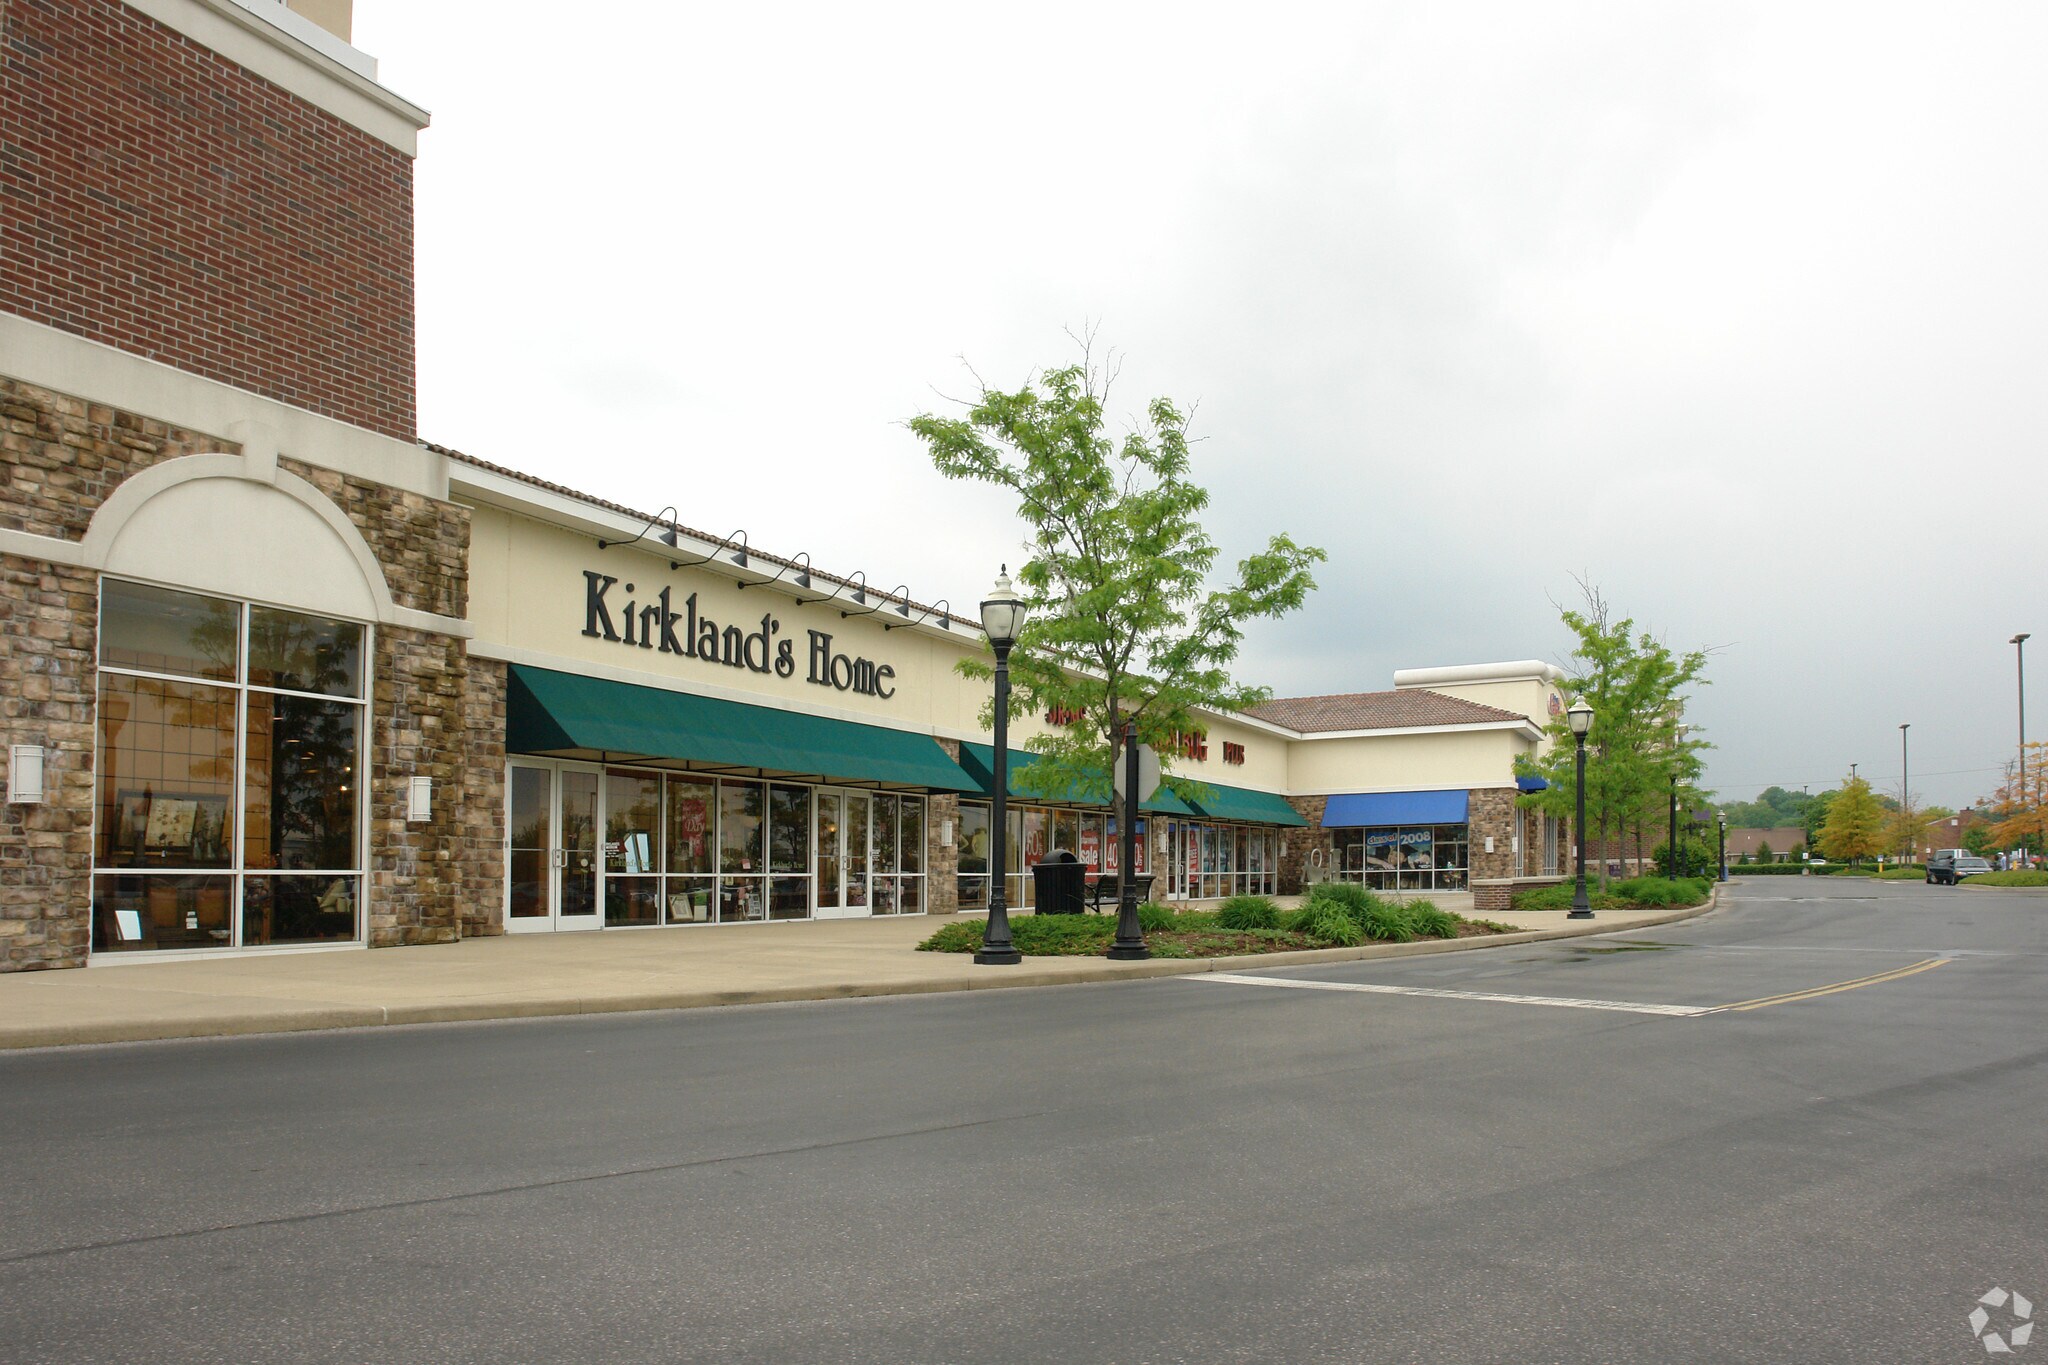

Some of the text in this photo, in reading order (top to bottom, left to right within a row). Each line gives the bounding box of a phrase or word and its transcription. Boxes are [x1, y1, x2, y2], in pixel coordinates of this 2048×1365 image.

[581, 570, 896, 700] Kirkland's Home
[1223, 741, 1245, 765] PLUS
[1400, 831, 1431, 845] 2008
[1080, 845, 1098, 866] sale
